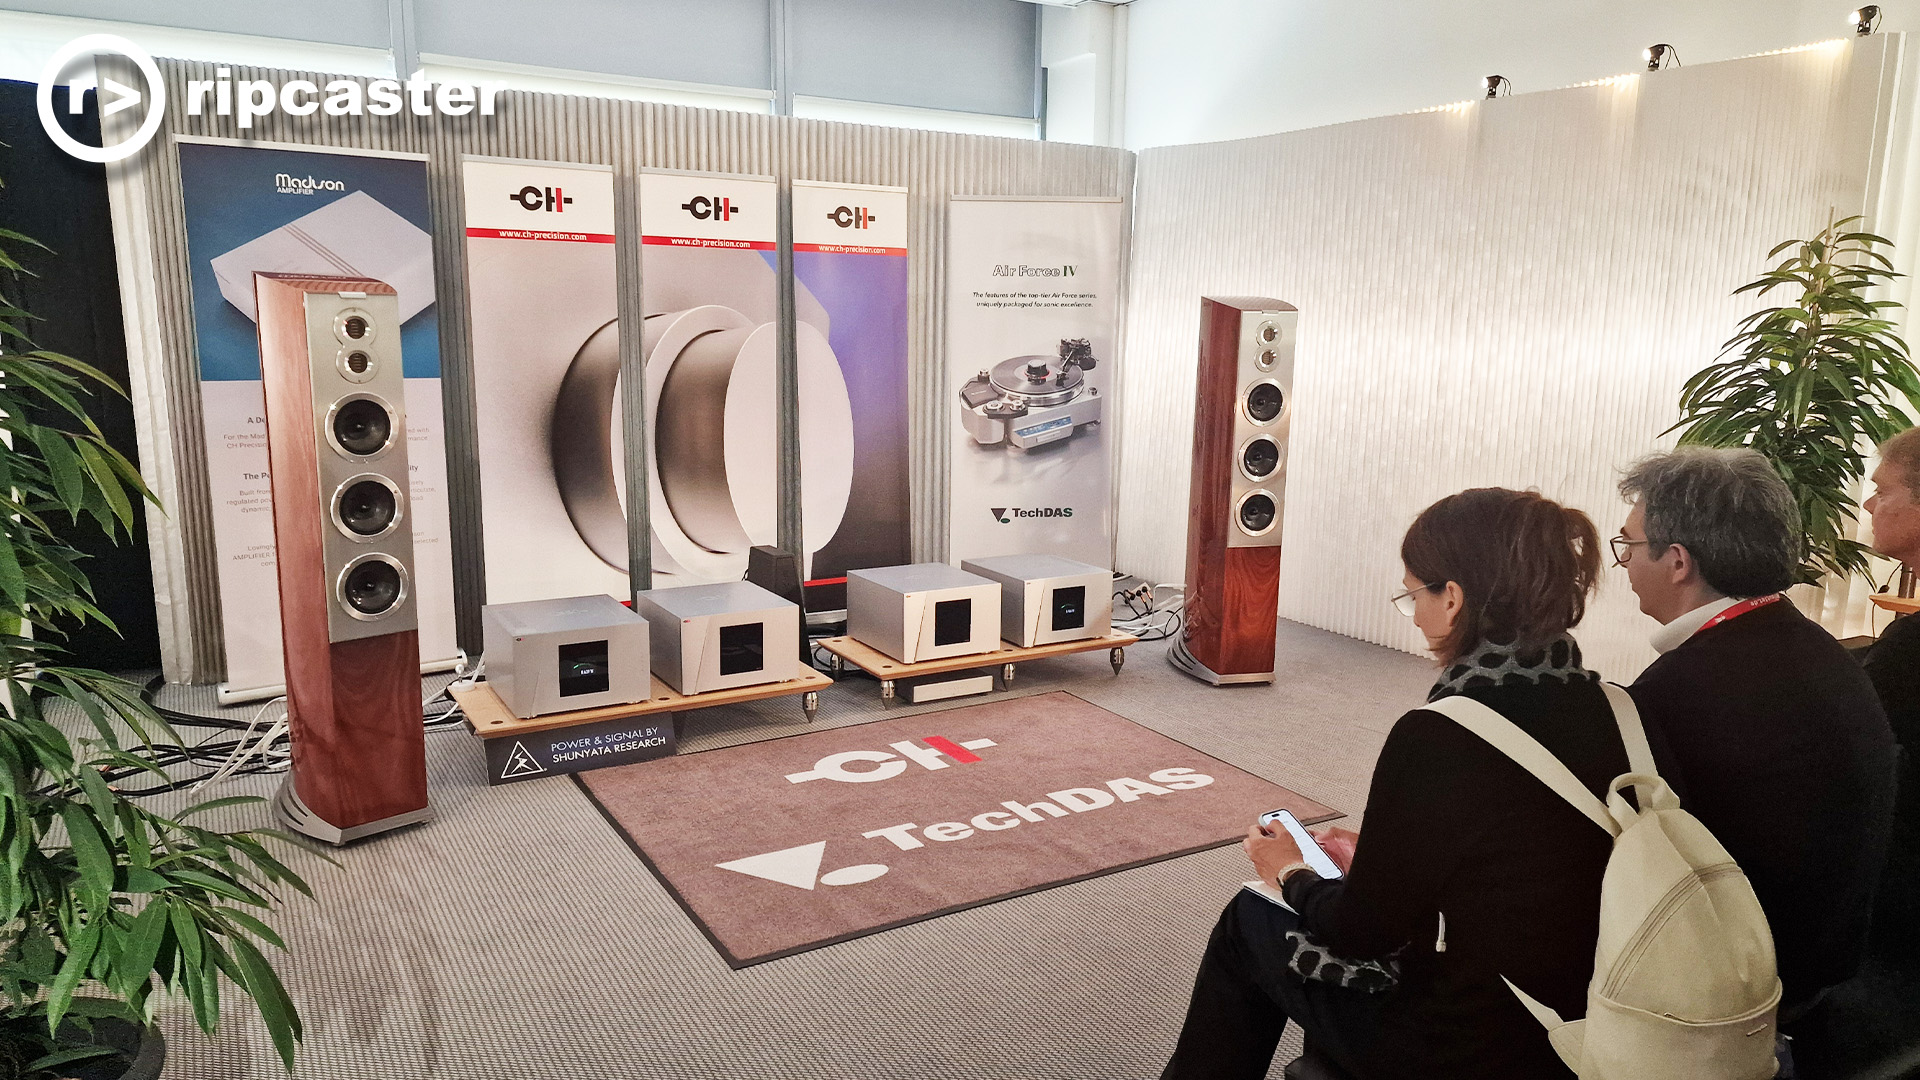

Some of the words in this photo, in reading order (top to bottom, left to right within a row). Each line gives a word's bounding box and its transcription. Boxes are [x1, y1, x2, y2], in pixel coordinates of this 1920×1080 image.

[275, 173, 345, 191] Madison
[277, 187, 314, 195] AMPLIFIER
[499, 230, 587, 241] www.ch-precision.com
[671, 238, 751, 248] www.ch-precision.com
[818, 245, 886, 254] www.ch-precision.com
[992, 265, 1016, 277] Air
[1018, 265, 1061, 277] Force
[1063, 265, 1078, 277] IV
[1012, 508, 1073, 518] TechDAS
[551, 738, 591, 752] POWER
[593, 736, 602, 746] &
[605, 729, 643, 743] SIGNAL
[646, 727, 658, 737] BY
[552, 746, 612, 763] SHUNYATA
[614, 736, 666, 753] RESEARCH
[862, 766, 1215, 851] TechDAS
